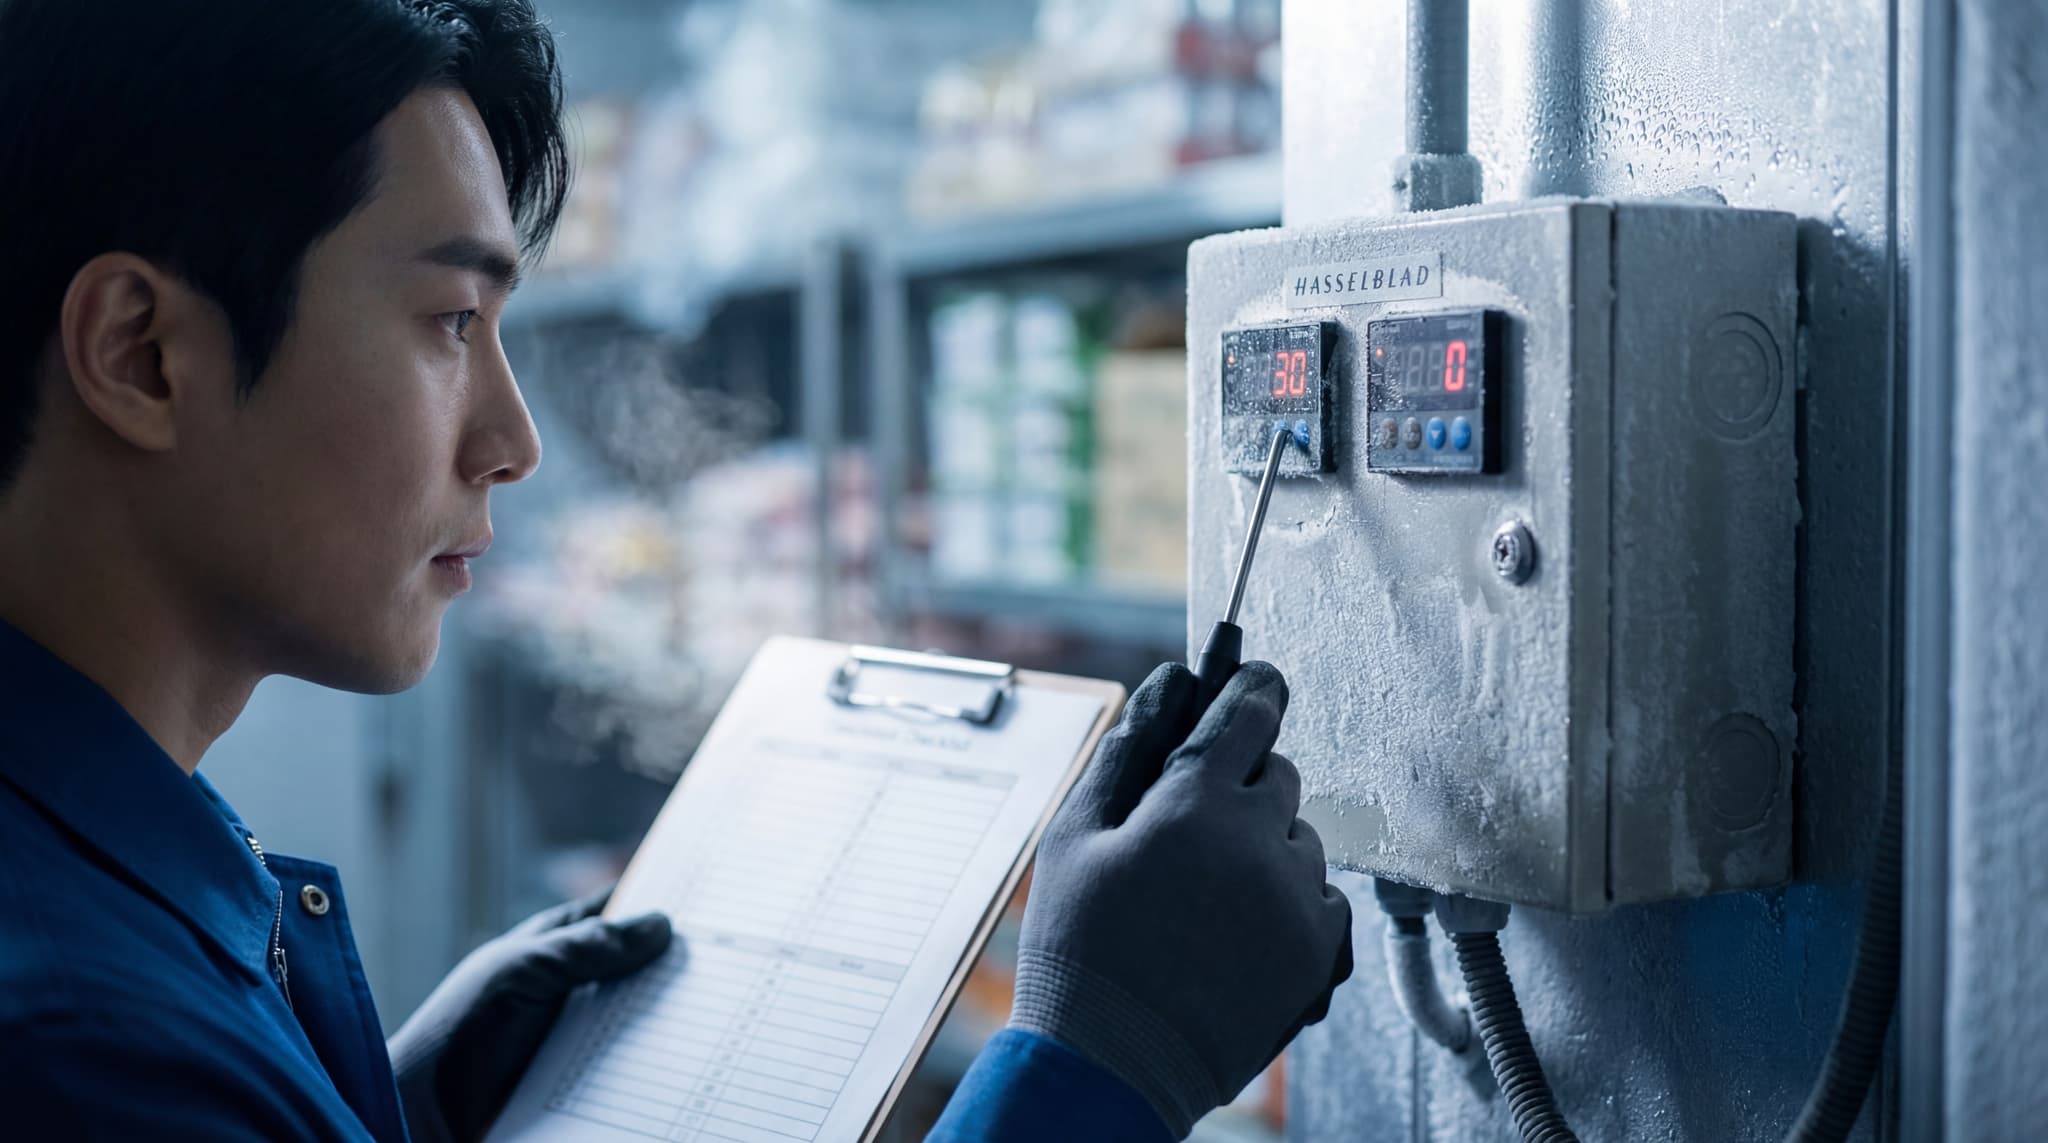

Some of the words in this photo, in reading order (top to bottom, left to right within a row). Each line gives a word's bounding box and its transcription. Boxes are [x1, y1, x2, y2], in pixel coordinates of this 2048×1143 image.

[1294, 265, 1429, 296] HASSELBLAD
[1272, 350, 1308, 398] 30
[1444, 340, 1467, 392] 0
